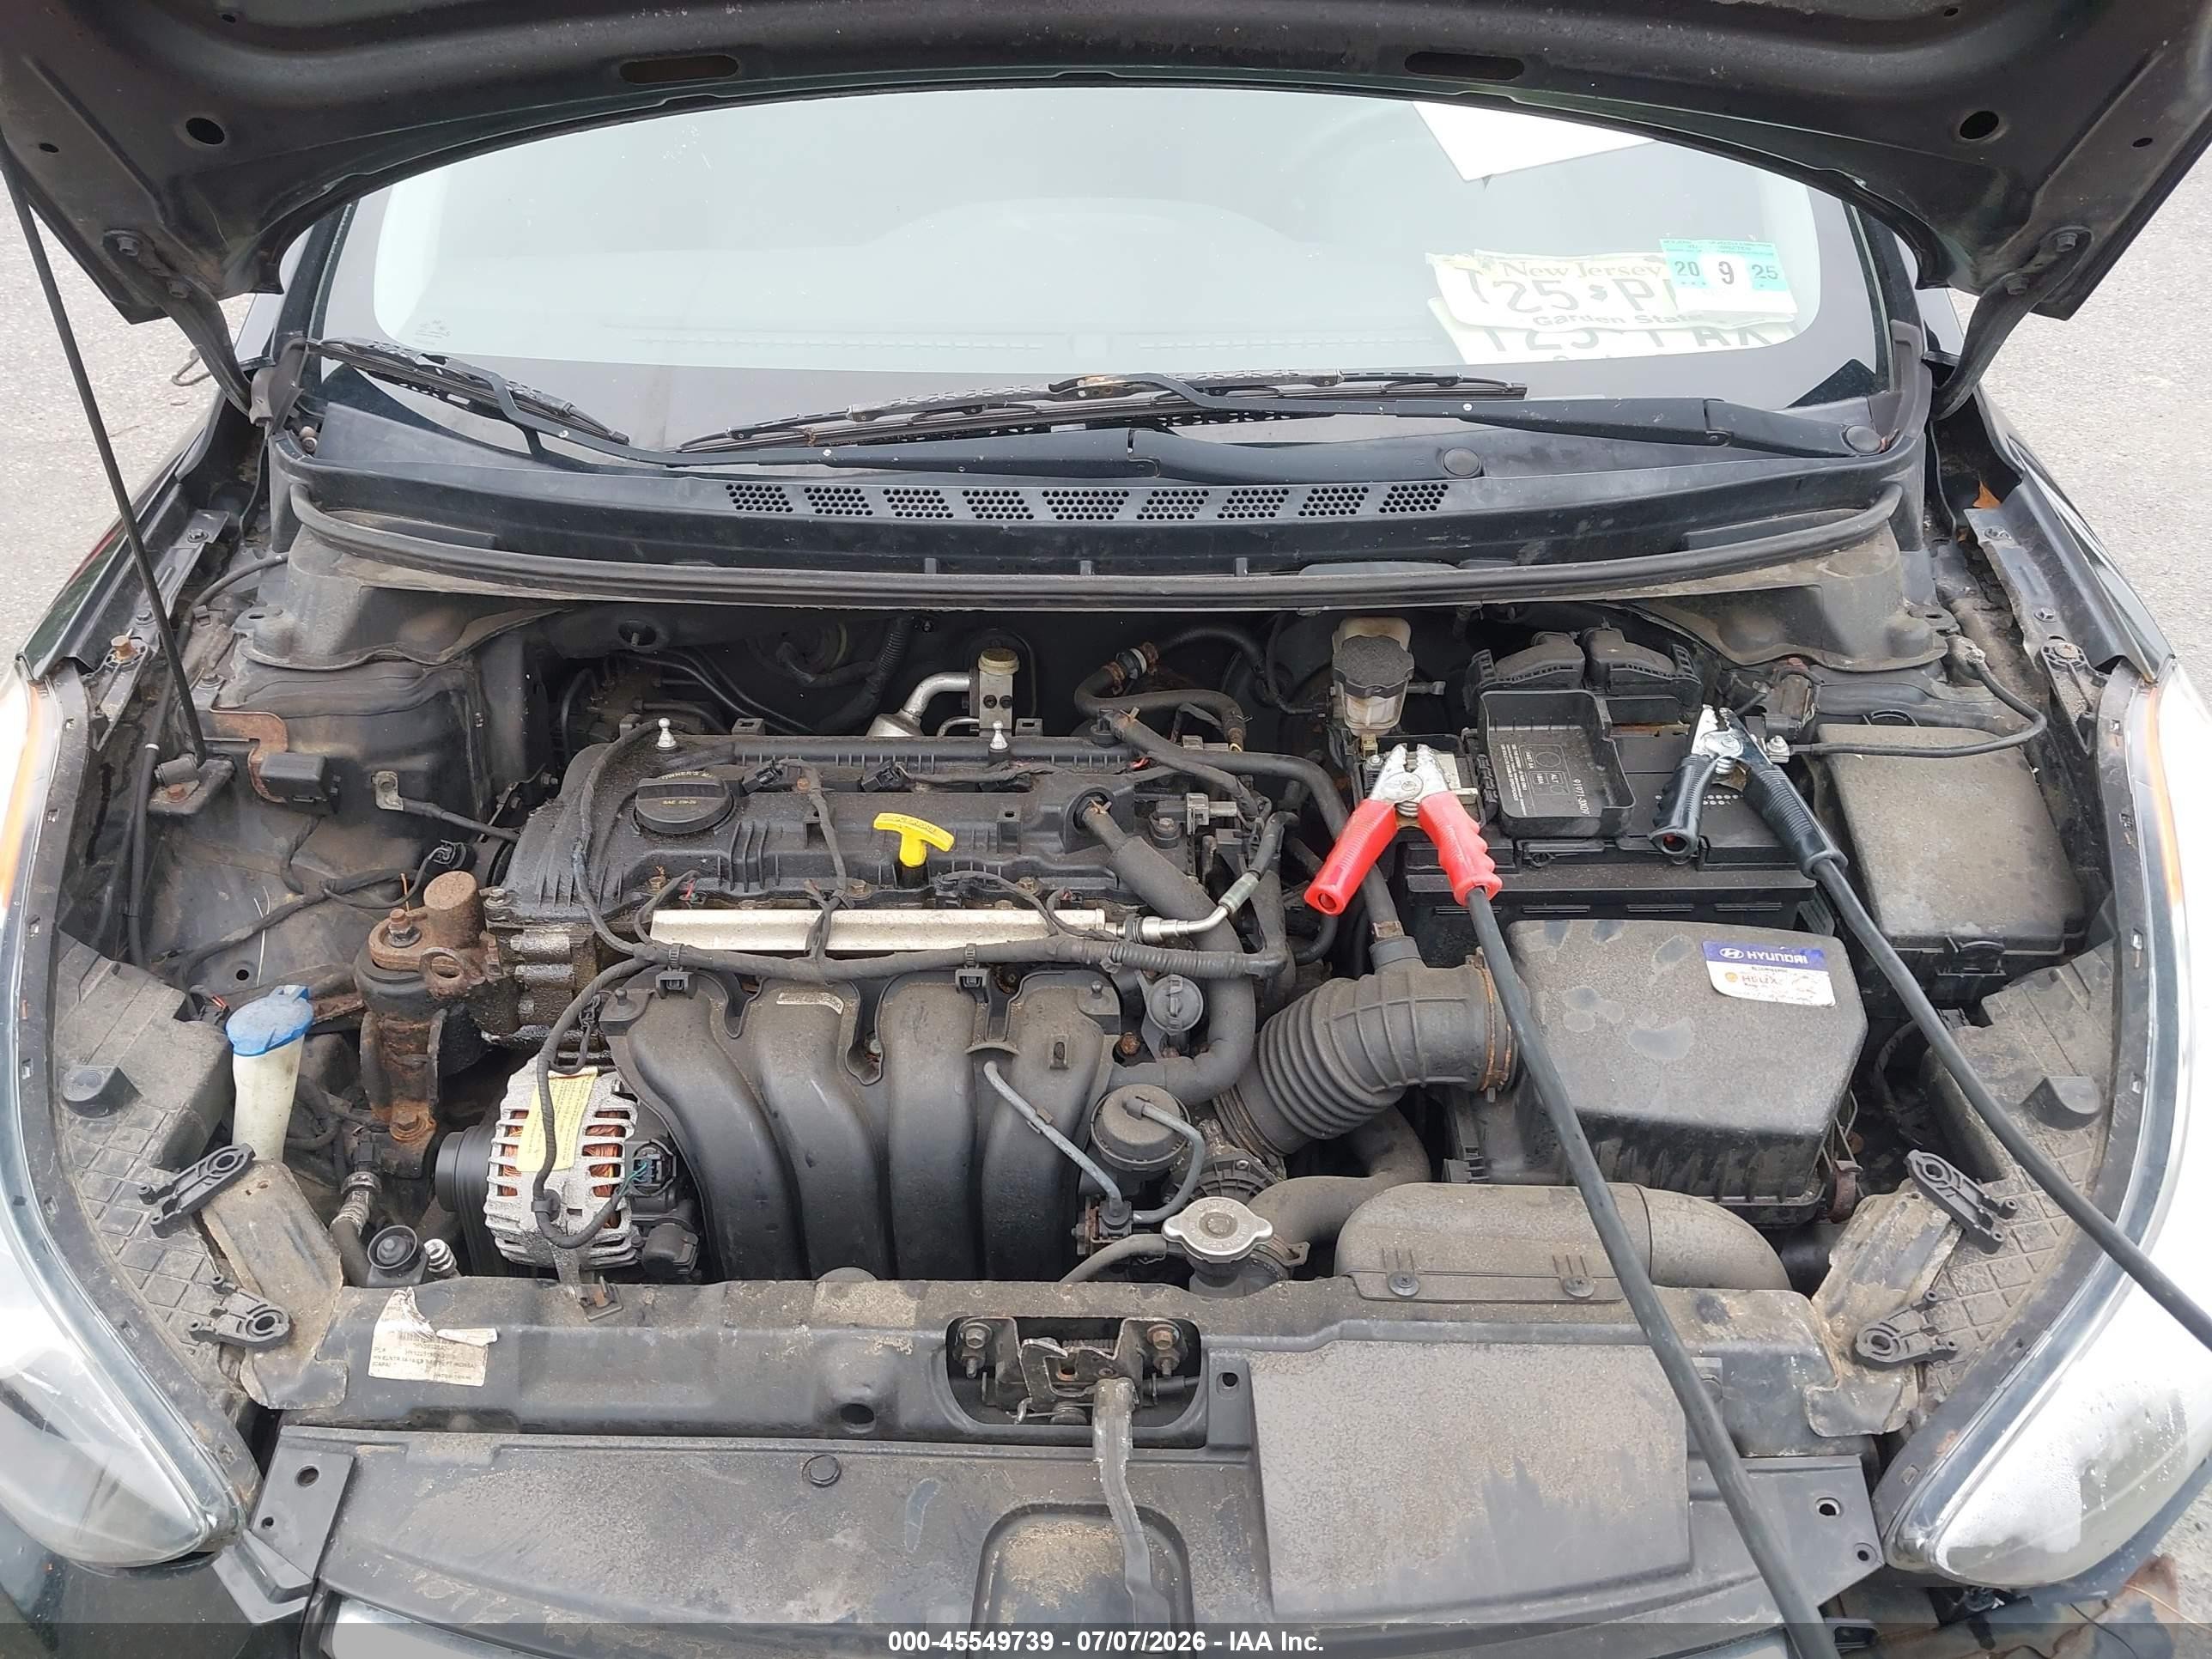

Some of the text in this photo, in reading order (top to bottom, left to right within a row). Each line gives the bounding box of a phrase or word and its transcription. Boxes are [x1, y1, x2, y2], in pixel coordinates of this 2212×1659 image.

[1500, 261, 1662, 281] New Jersey
[1674, 260, 1779, 285] 20 9 25
[1532, 313, 1626, 326] Garden
[1747, 950, 1809, 964] HYUNDAI
